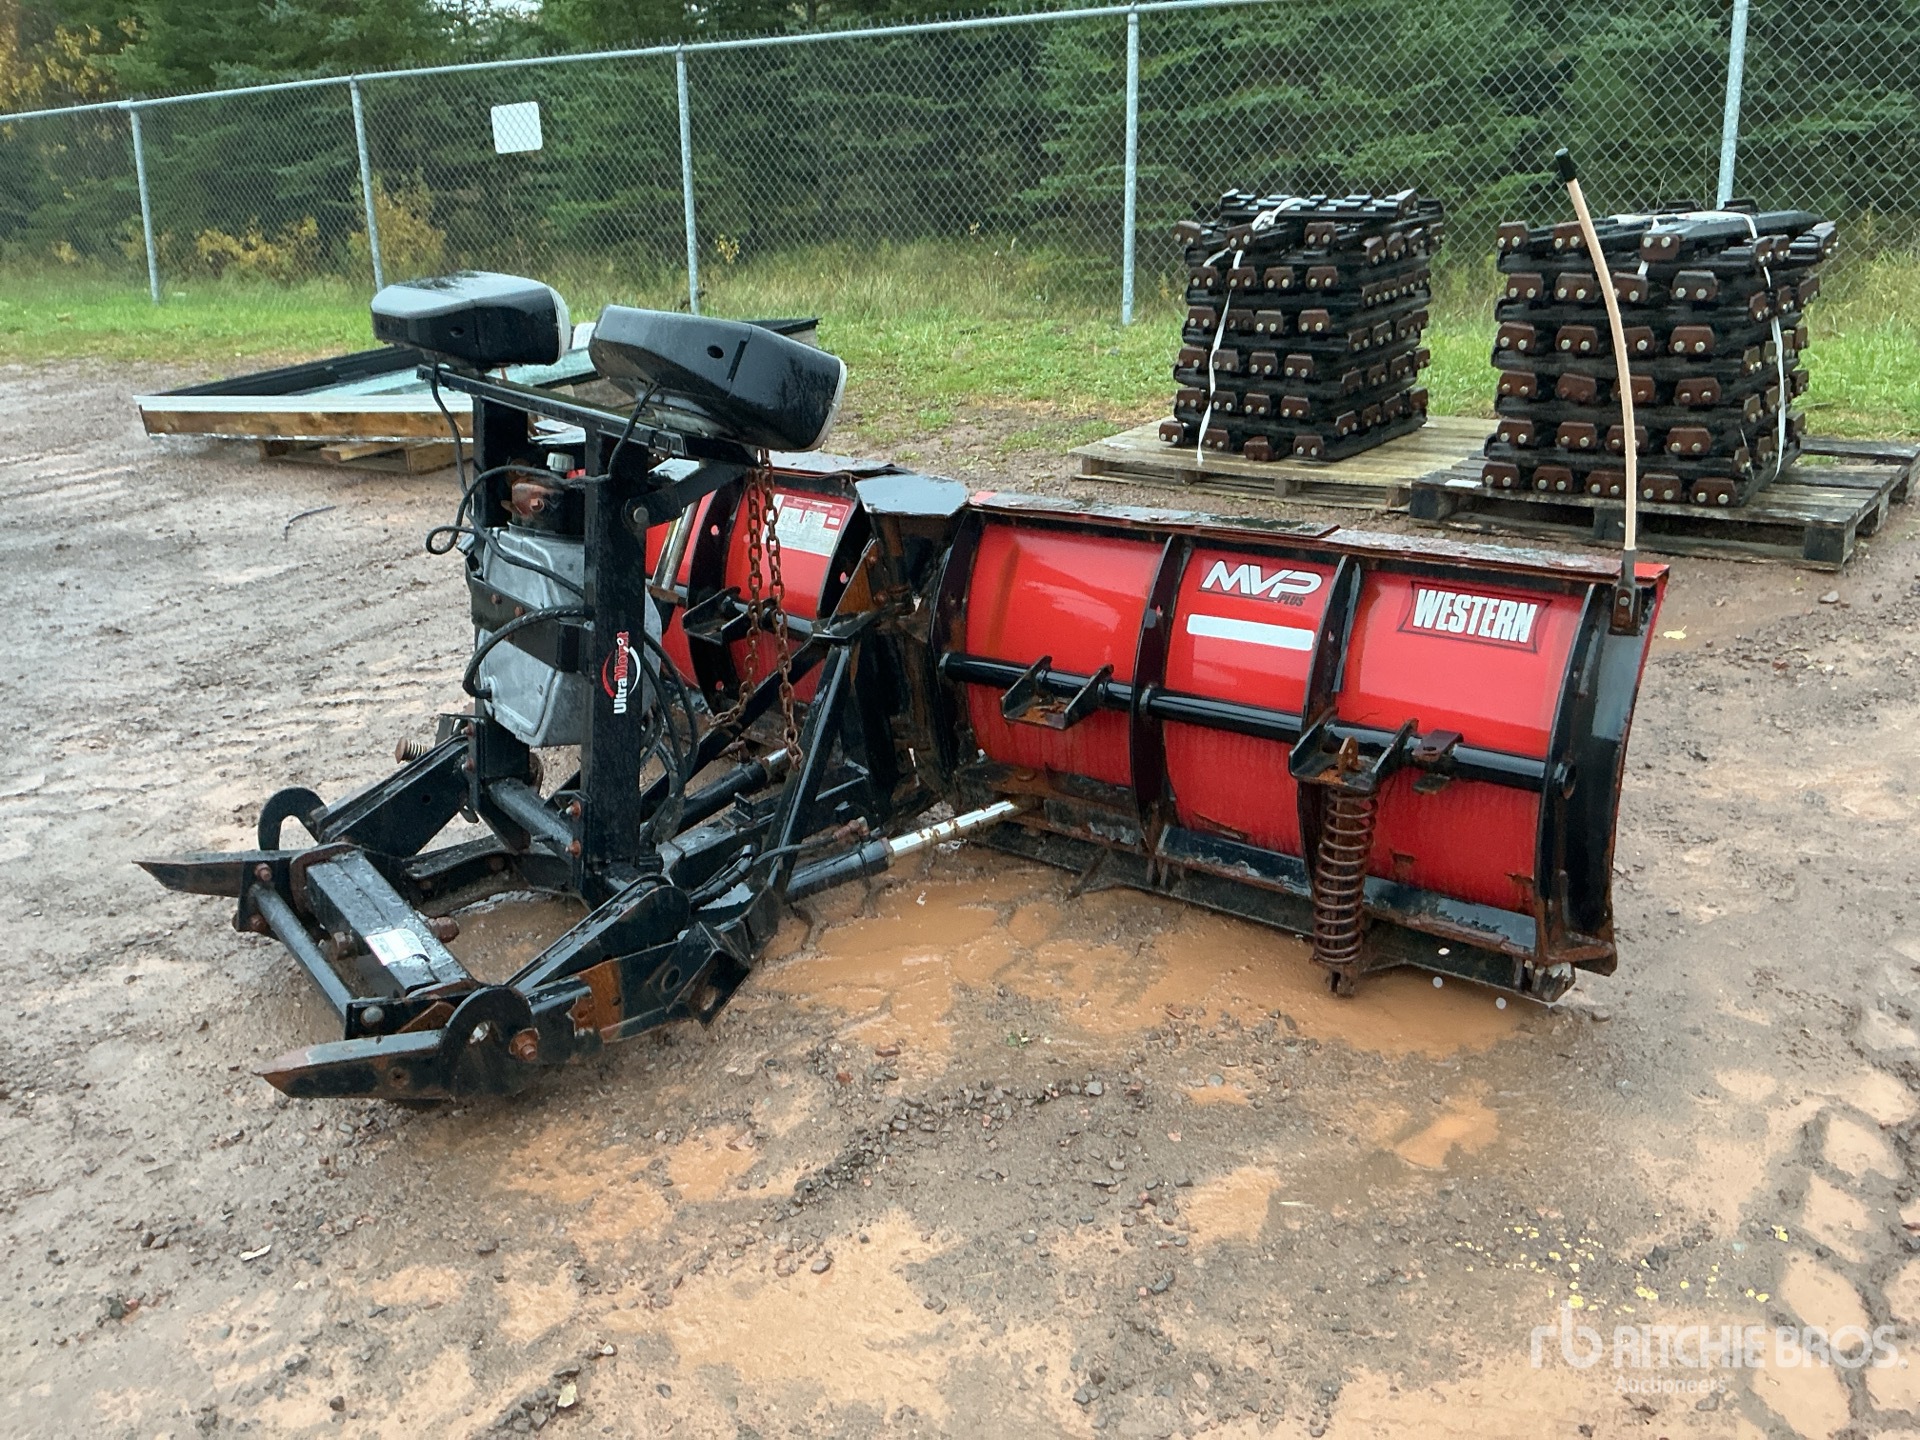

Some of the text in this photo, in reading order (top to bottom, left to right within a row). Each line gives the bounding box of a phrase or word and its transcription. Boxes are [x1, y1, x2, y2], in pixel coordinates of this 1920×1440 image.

[1201, 560, 1323, 598] MVP
[1278, 594, 1306, 607] PLUS
[1412, 588, 1538, 643] WESTERN
